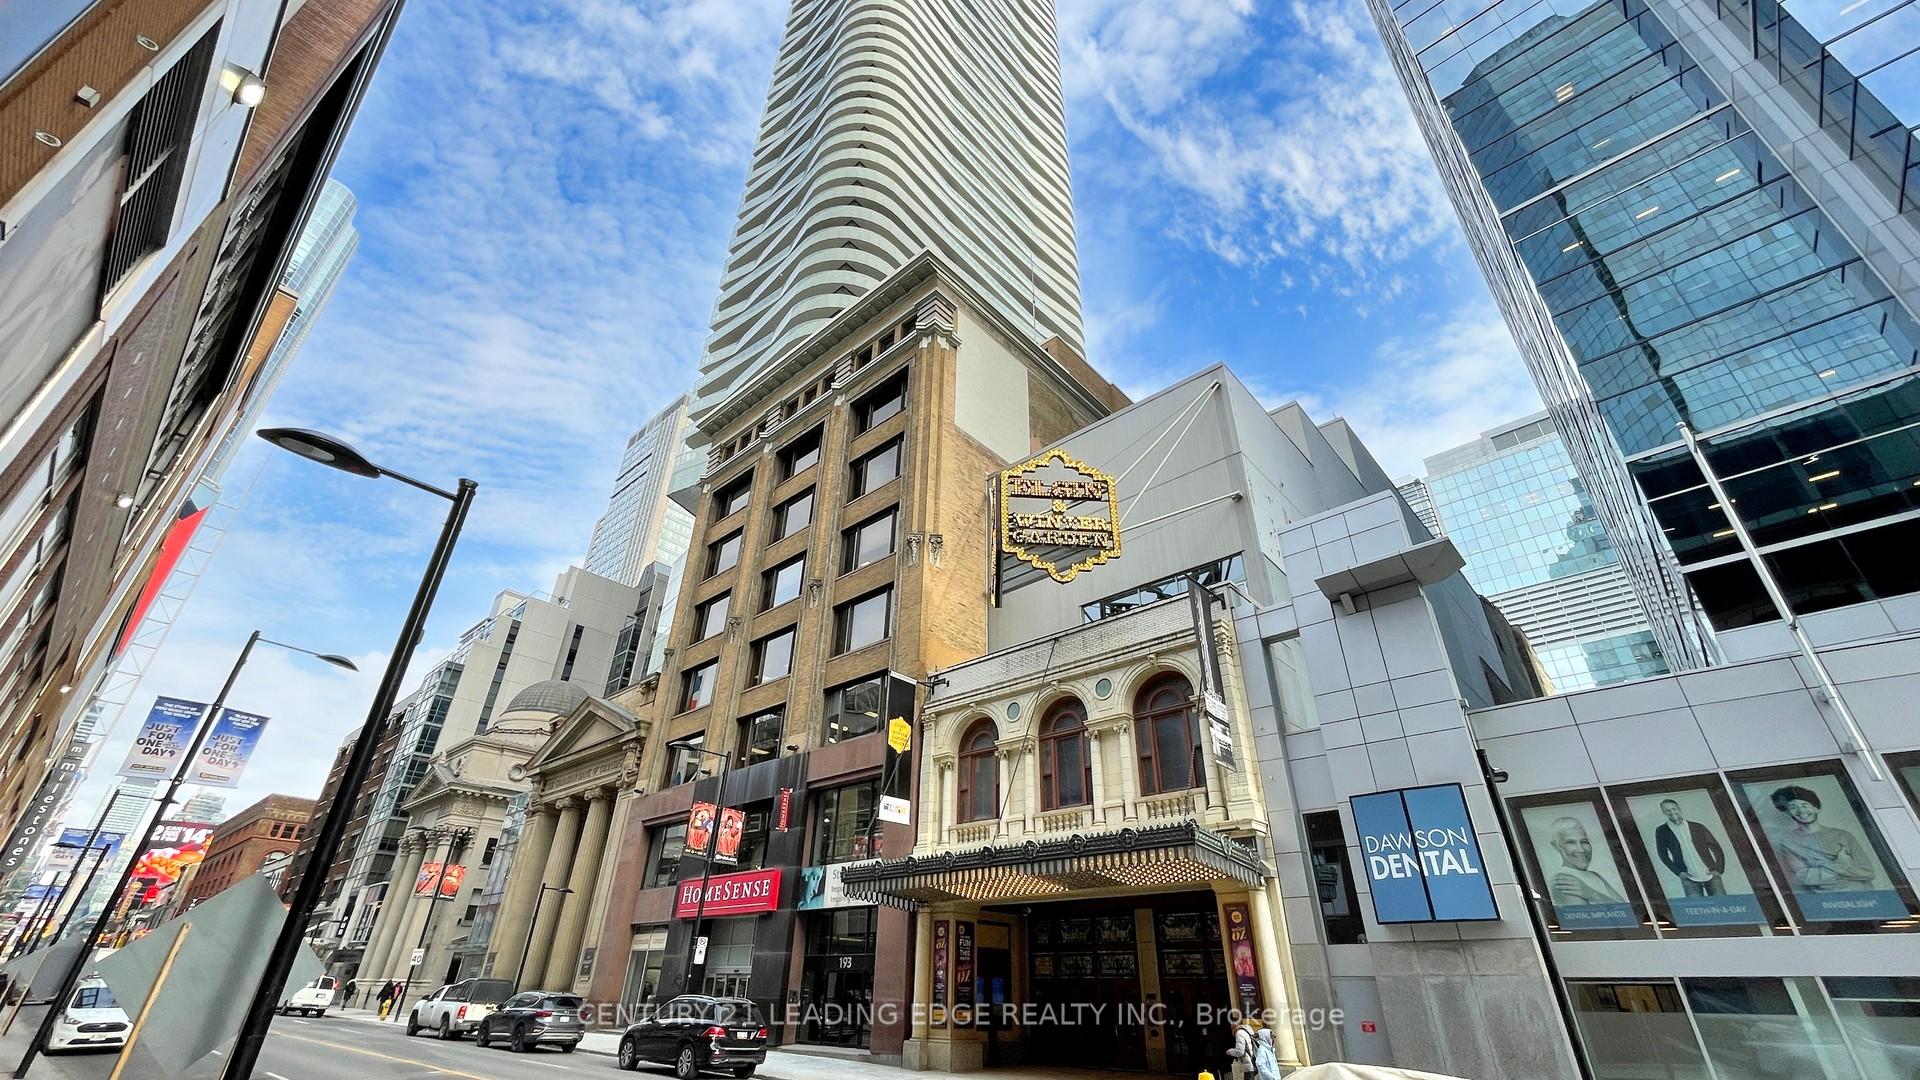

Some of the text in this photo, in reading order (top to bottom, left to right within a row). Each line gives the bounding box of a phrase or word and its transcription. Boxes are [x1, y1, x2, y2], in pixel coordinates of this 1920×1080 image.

[1014, 513, 1109, 531] WINTER
[1013, 530, 1109, 547] GARDEN
[146, 723, 181, 734] JUST
[136, 737, 162, 748] ONE
[148, 732, 174, 741] FOR
[212, 734, 245, 746] JUST
[202, 747, 228, 758] ONE
[214, 743, 238, 753] FOR
[6, 761, 77, 867] milestones
[150, 824, 165, 841] 2
[1364, 826, 1469, 854] DAWSON
[1369, 848, 1479, 881] DENTAL
[1684, 905, 1747, 915] TEETH-IN-A-DAY
[411, 955, 422, 964] 40
[839, 956, 852, 969] 193
